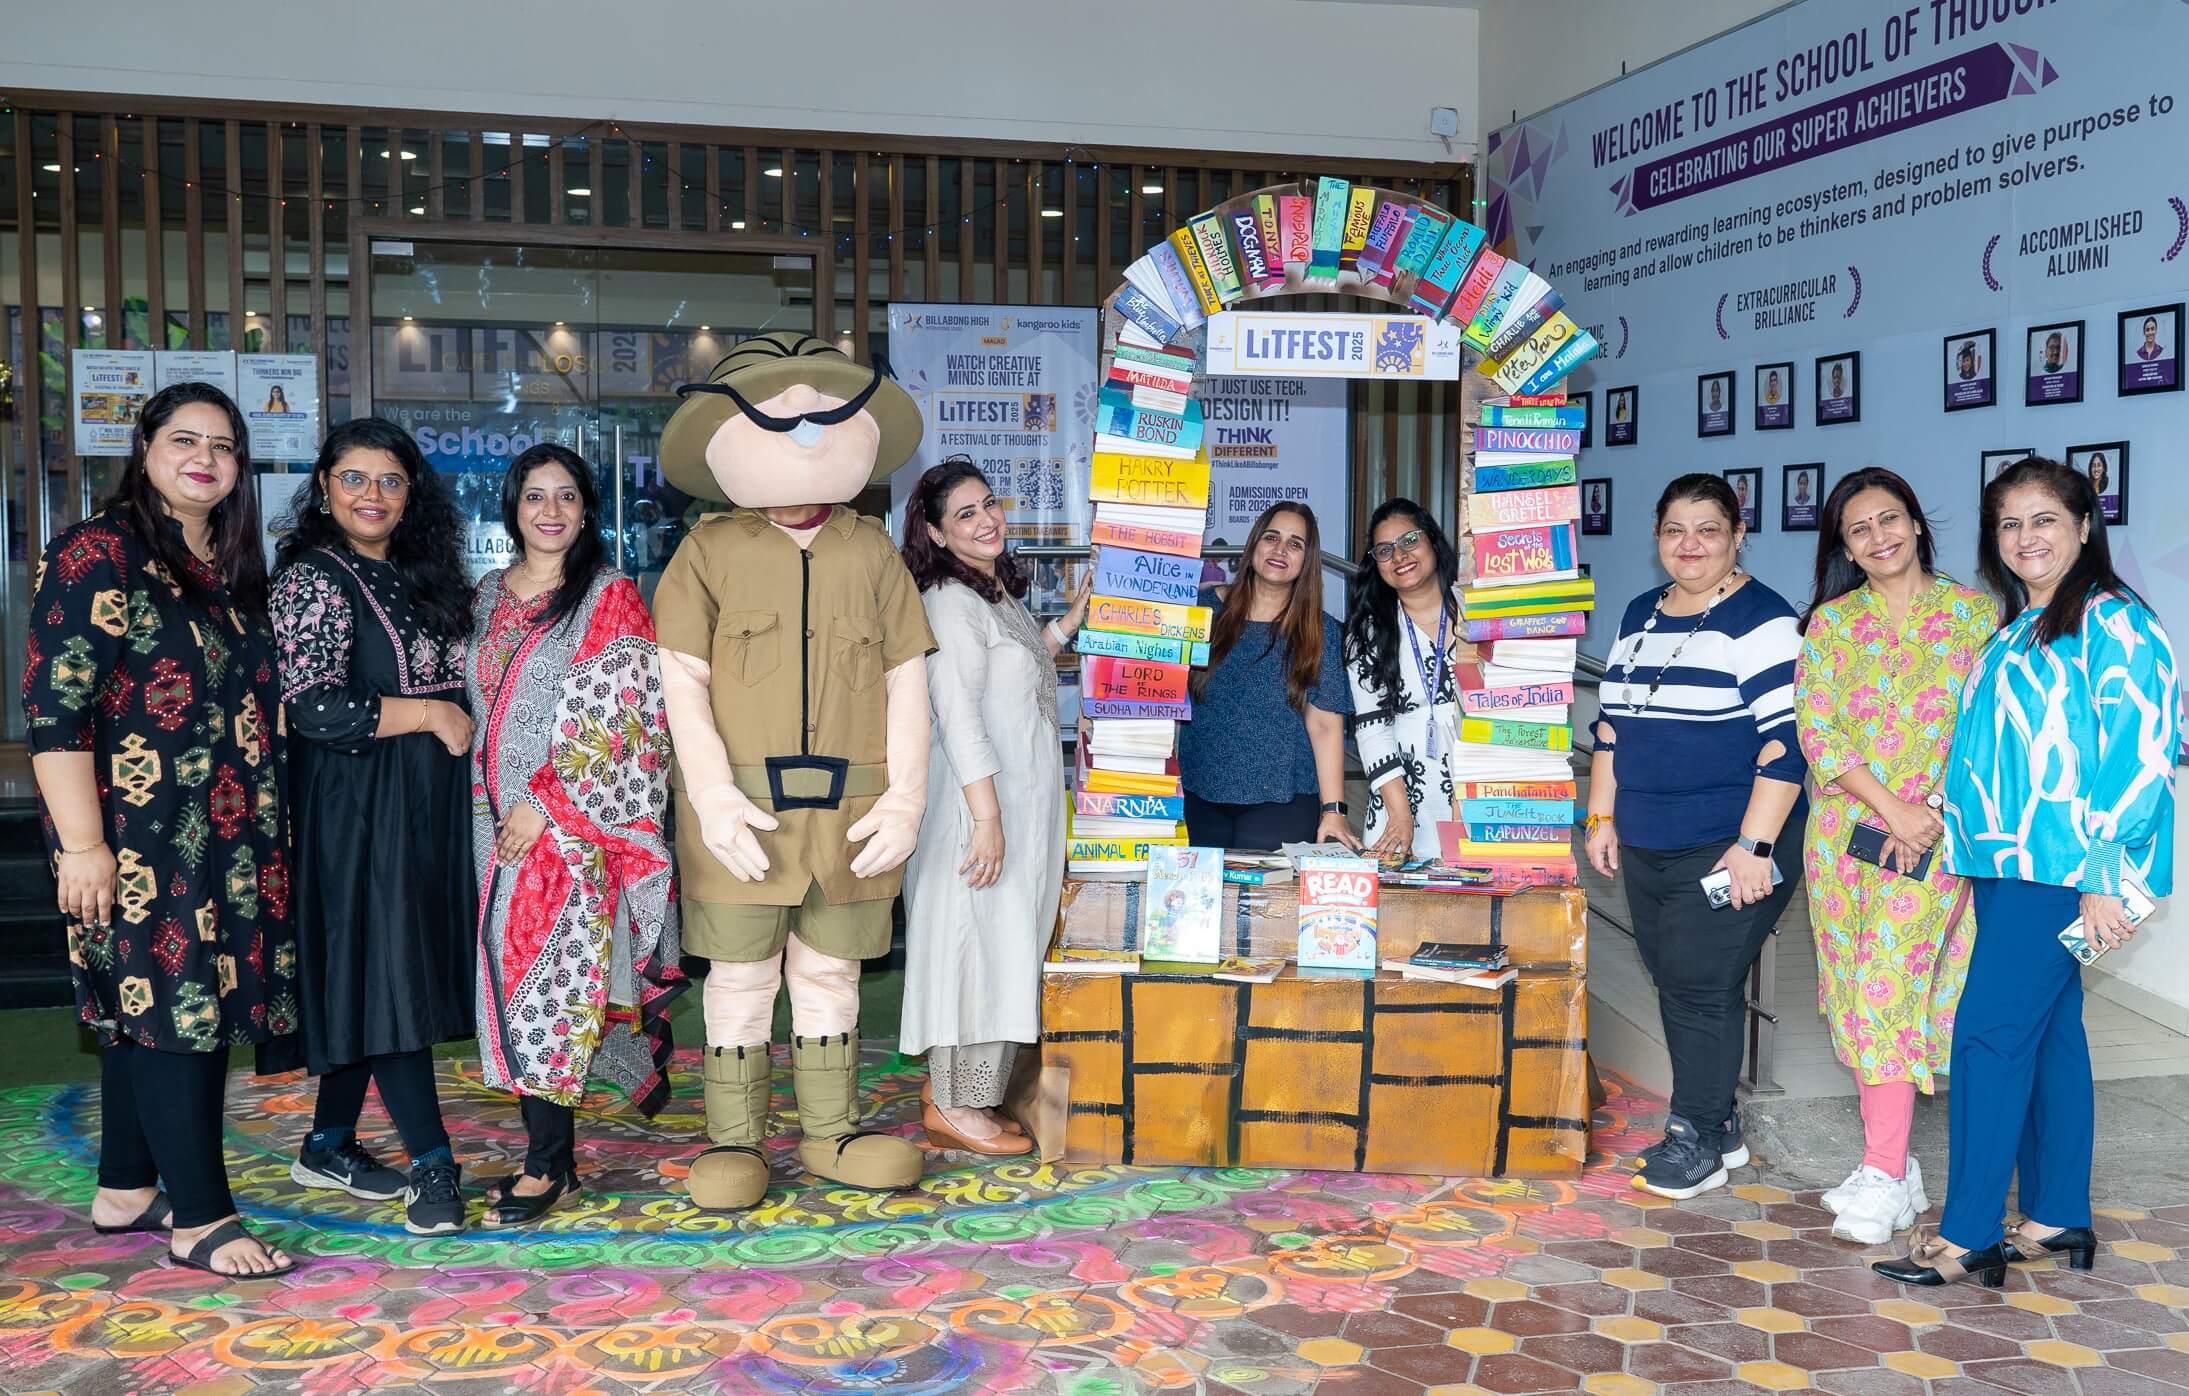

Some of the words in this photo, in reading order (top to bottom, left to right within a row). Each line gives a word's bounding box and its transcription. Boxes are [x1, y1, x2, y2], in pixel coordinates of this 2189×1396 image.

[1592, 100, 1684, 168] WELCOME
[1692, 87, 1717, 132] TO
[1725, 67, 1769, 120] THE
[1775, 27, 1873, 102] SCHOOL
[1884, 7, 1920, 62] OF
[1650, 141, 1748, 198] CELEBRATING
[1753, 128, 1785, 165] OUR
[1791, 107, 1848, 152] SUPER
[1854, 67, 1966, 134] ACHIEVERS
[1549, 263, 1563, 278] An
[1566, 248, 1616, 272] engaging
[1619, 238, 1642, 259] and
[1645, 222, 1709, 252] rewarding
[1713, 206, 1771, 235] learning
[1776, 181, 1868, 218] ecosystem,
[1874, 149, 1959, 191] designed
[1966, 145, 1985, 165] to
[1992, 134, 2036, 163] give
[2044, 103, 2140, 150] purpose
[2149, 93, 2174, 118] to
[1290, 198, 1309, 261] DRAGONS
[1344, 201, 1365, 244] FAMOUS
[1358, 213, 1369, 239] FIVE
[1584, 270, 1629, 292] learning
[1633, 259, 1656, 280] and
[1659, 251, 1693, 273] allow
[1697, 237, 1752, 264] children
[1757, 232, 1772, 249] to
[1777, 226, 1795, 244] be
[1800, 207, 1866, 238] thinkers
[1872, 194, 1905, 215] and
[1911, 174, 1991, 216] problem
[1999, 153, 2085, 189] solvers.
[2019, 210, 2143, 256] ACCOMPLISHED
[1210, 232, 1233, 276] HOLMES
[2047, 245, 2109, 277] ALUMNI
[1460, 267, 1494, 310] Heidi
[1737, 274, 1836, 312] EXTRACURRICULAR
[925, 315, 969, 326] BILLABONG
[971, 316, 989, 326] HIGH
[1017, 319, 1060, 334] kangaroo
[1755, 302, 1815, 331] BRILLIANCE
[1352, 331, 1364, 361] 2025
[1490, 320, 1526, 353] CHARLIE
[947, 354, 986, 371] WATCH
[989, 355, 1041, 372] CREATIVE
[948, 370, 985, 386] MINDS
[988, 371, 1024, 386] IGNITE
[1027, 372, 1040, 386] AT
[1221, 379, 1247, 394] JUST
[1250, 380, 1272, 395] USE
[384, 407, 409, 418] We
[414, 409, 440, 421] are
[446, 408, 471, 421] the
[1011, 401, 1019, 423] 2025
[1138, 412, 1184, 430] RUSKIN
[1202, 398, 1265, 421] DESIGN
[1268, 399, 1290, 422] IT!
[416, 426, 543, 456] School
[941, 433, 947, 445] A
[950, 433, 989, 446] FESTIVAL
[991, 434, 1001, 446] OF
[1004, 434, 1048, 446] THOUGHTS
[1136, 427, 1177, 444] BOND
[1216, 427, 1273, 444] THINK
[1487, 430, 1572, 449] PINOCCHIO
[1214, 446, 1275, 457] DIFFERENT
[983, 459, 1011, 474] 2025
[1120, 458, 1174, 476] HARRY
[1000, 476, 1011, 487] PM
[1116, 479, 1189, 503] POTTER
[1229, 486, 1283, 499] ADMISSIONS
[1285, 487, 1308, 499] OPEN
[1229, 500, 1246, 512] FOR
[1491, 490, 1552, 509] HANSEL
[1107, 525, 1136, 542] THE
[1145, 531, 1187, 548] HOBBIT
[1135, 556, 1181, 578] Alice
[1106, 572, 1198, 599] WONDERLAND
[1098, 602, 1161, 626] CHARLES
[1161, 624, 1205, 639] DICKENS
[1084, 635, 1128, 653] Arabian
[1136, 640, 1173, 660] Nights
[1122, 666, 1164, 681] LORD
[1102, 683, 1127, 695] THE
[1138, 687, 1177, 699] RINGS
[1468, 693, 1509, 709] Tales
[1520, 685, 1564, 707] India
[1094, 702, 1132, 715] SUDHA
[1139, 705, 1186, 718] MURTHY
[1517, 725, 1546, 739] Forest
[1083, 795, 1168, 817] NARNIA
[1485, 825, 1558, 841] RAPUNZEL
[1072, 843, 1126, 859] ANIMAL
[1177, 851, 1199, 869] 51
[1307, 873, 1372, 898] READ
